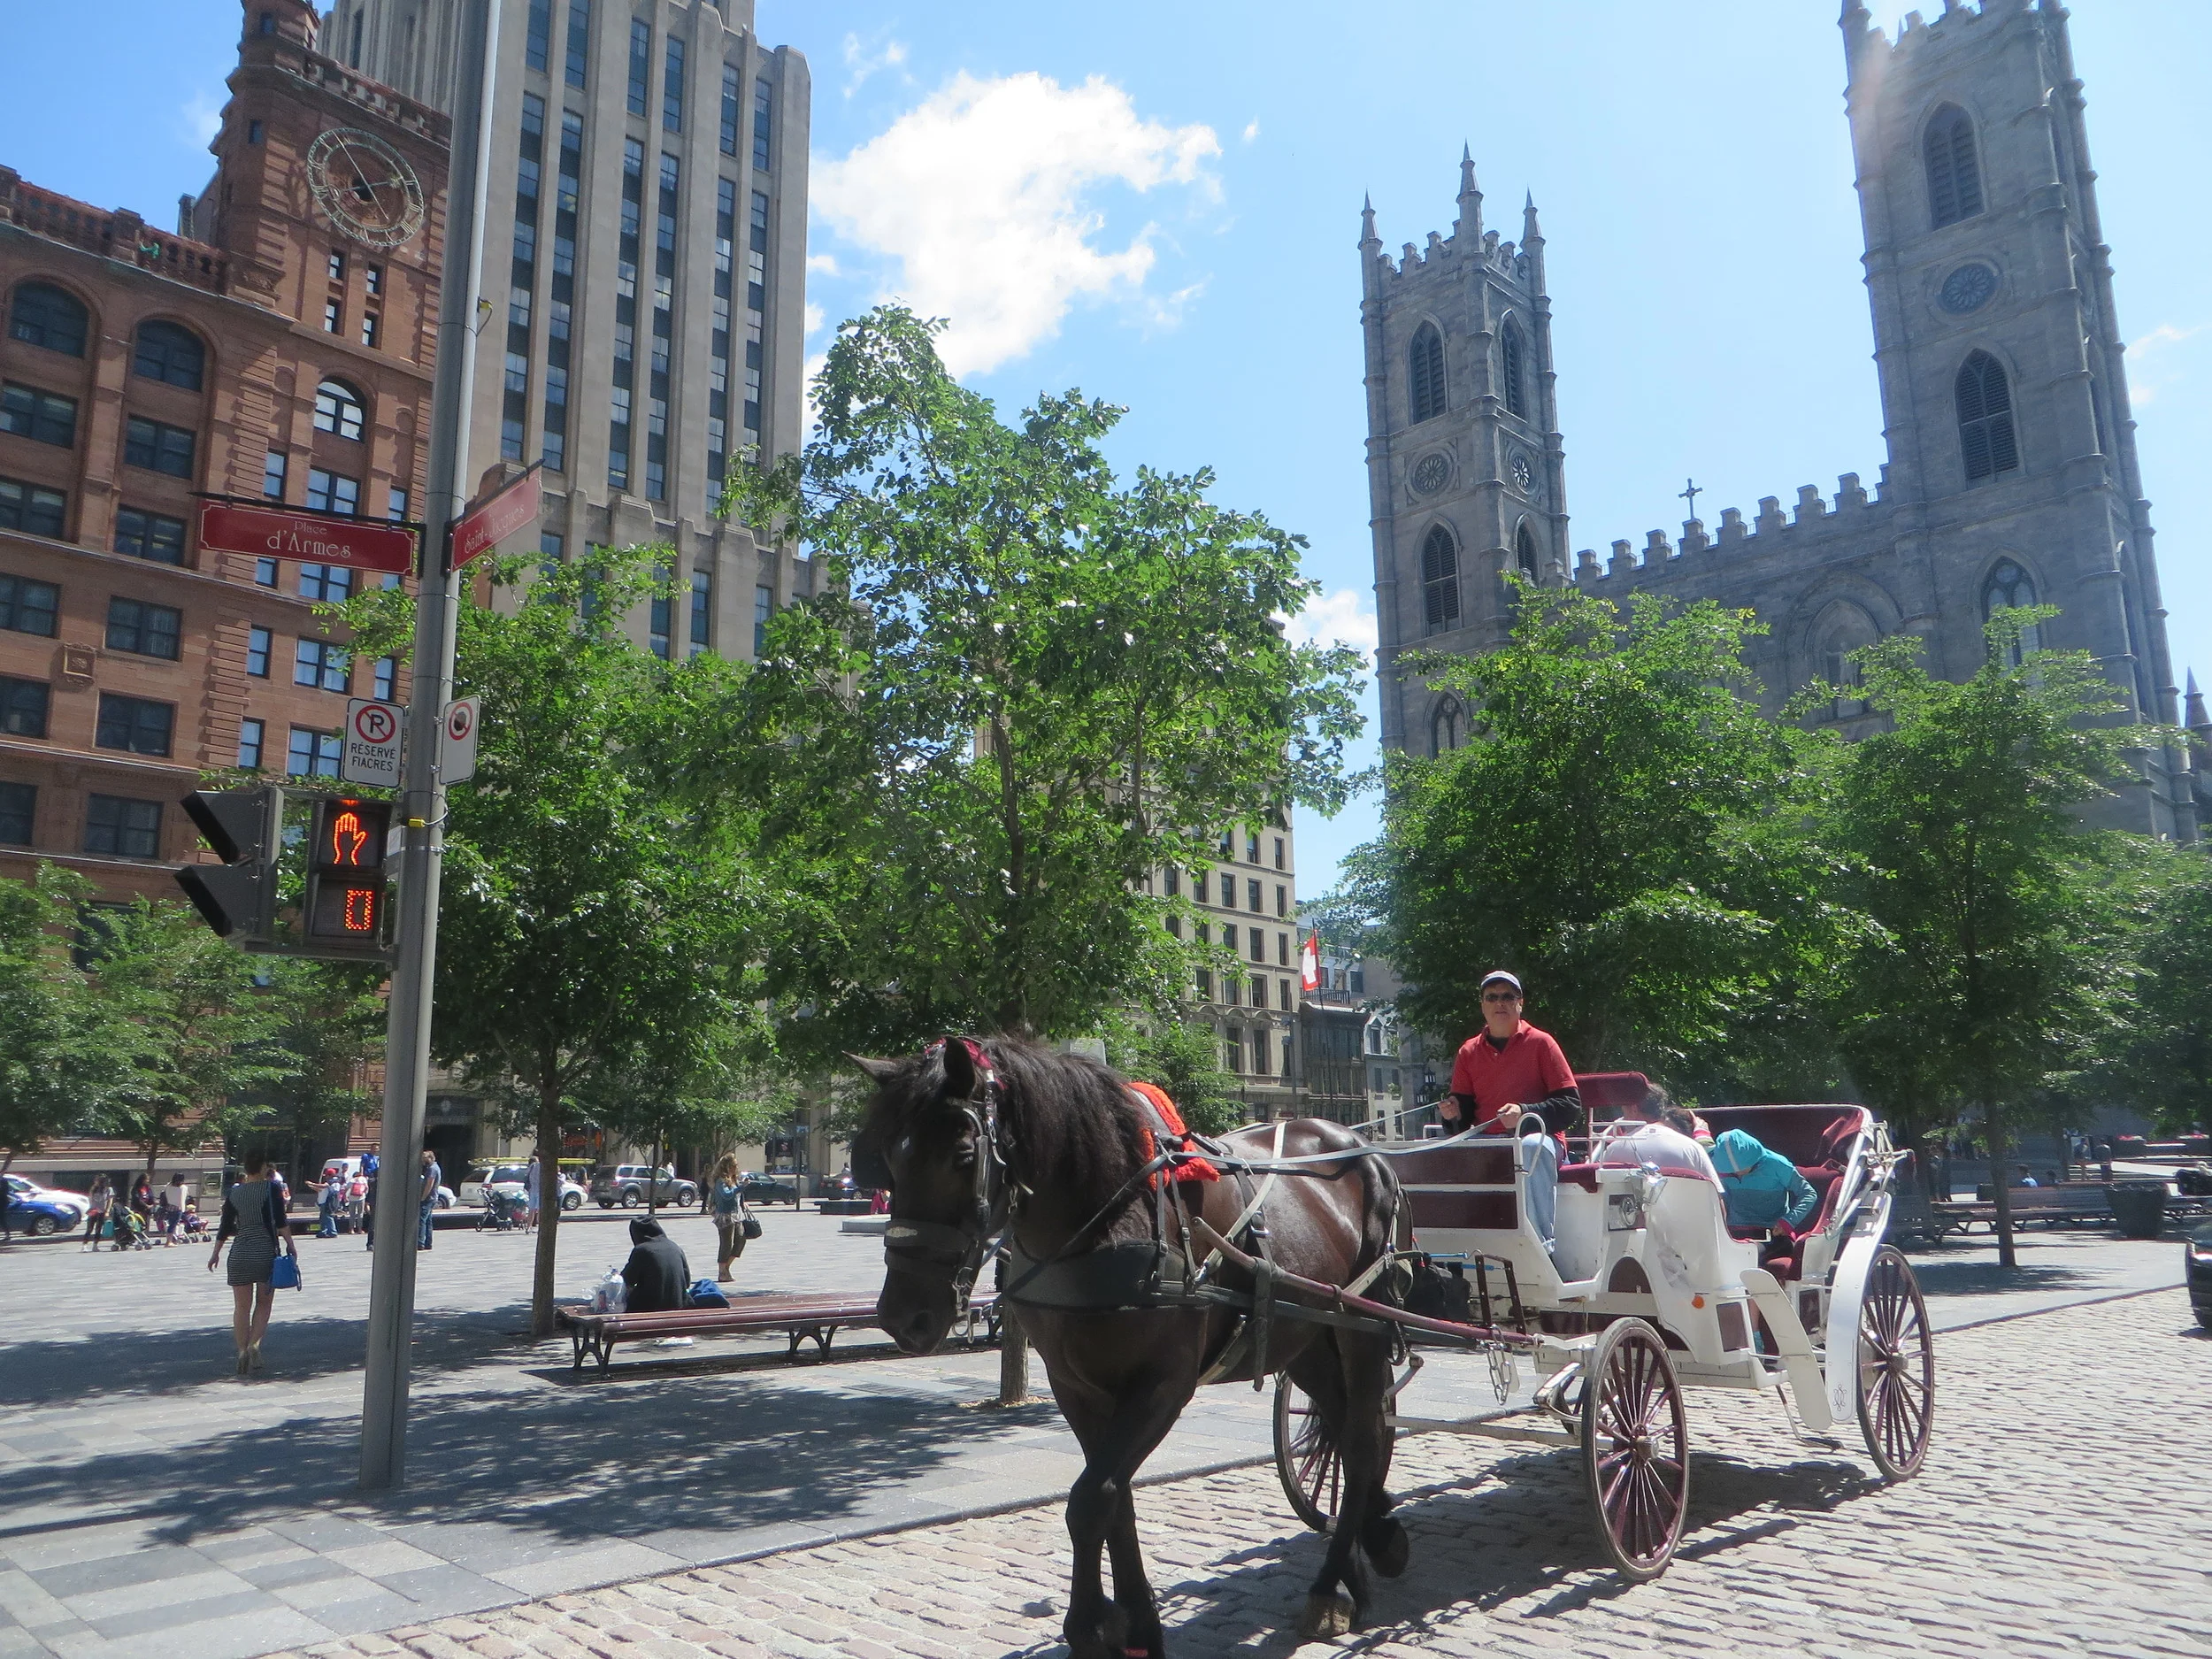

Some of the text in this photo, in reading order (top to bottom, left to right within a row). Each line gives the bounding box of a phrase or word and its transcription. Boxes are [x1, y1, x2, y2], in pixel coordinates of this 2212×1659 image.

[294, 520, 327, 535] Place
[266, 530, 351, 558] d'Armes
[370, 713, 385, 733] P
[350, 741, 396, 760] RÉSERVÉ
[352, 756, 394, 772] FIACRES
